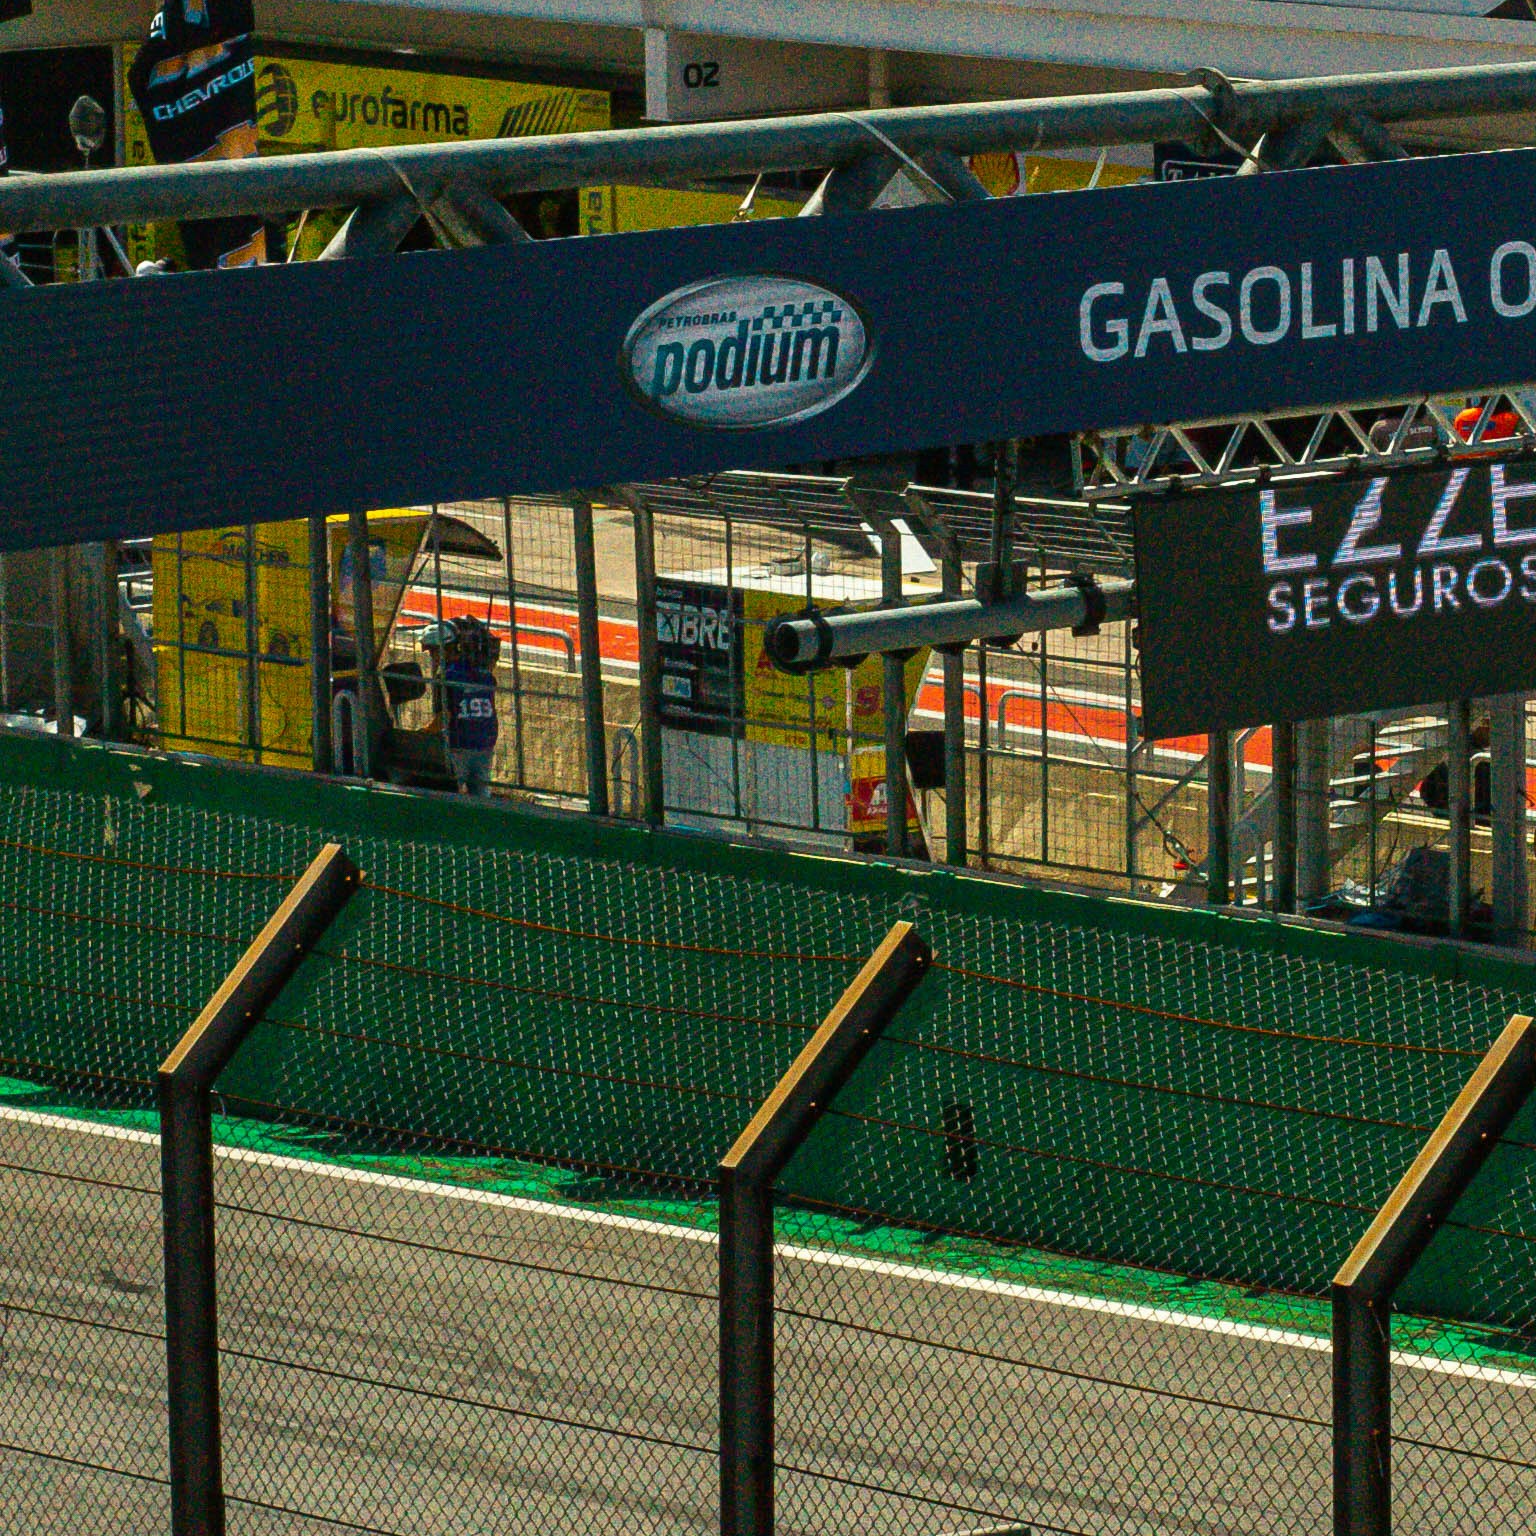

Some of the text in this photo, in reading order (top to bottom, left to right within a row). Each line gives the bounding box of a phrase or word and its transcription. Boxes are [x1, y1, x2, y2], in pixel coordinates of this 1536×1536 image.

[682, 61, 721, 89] 02
[311, 86, 470, 137] eurofarma
[657, 310, 737, 330] PETROBRAS
[1079, 248, 1469, 362] GASOLINA
[652, 317, 840, 396] podium
[457, 697, 493, 719] 193
